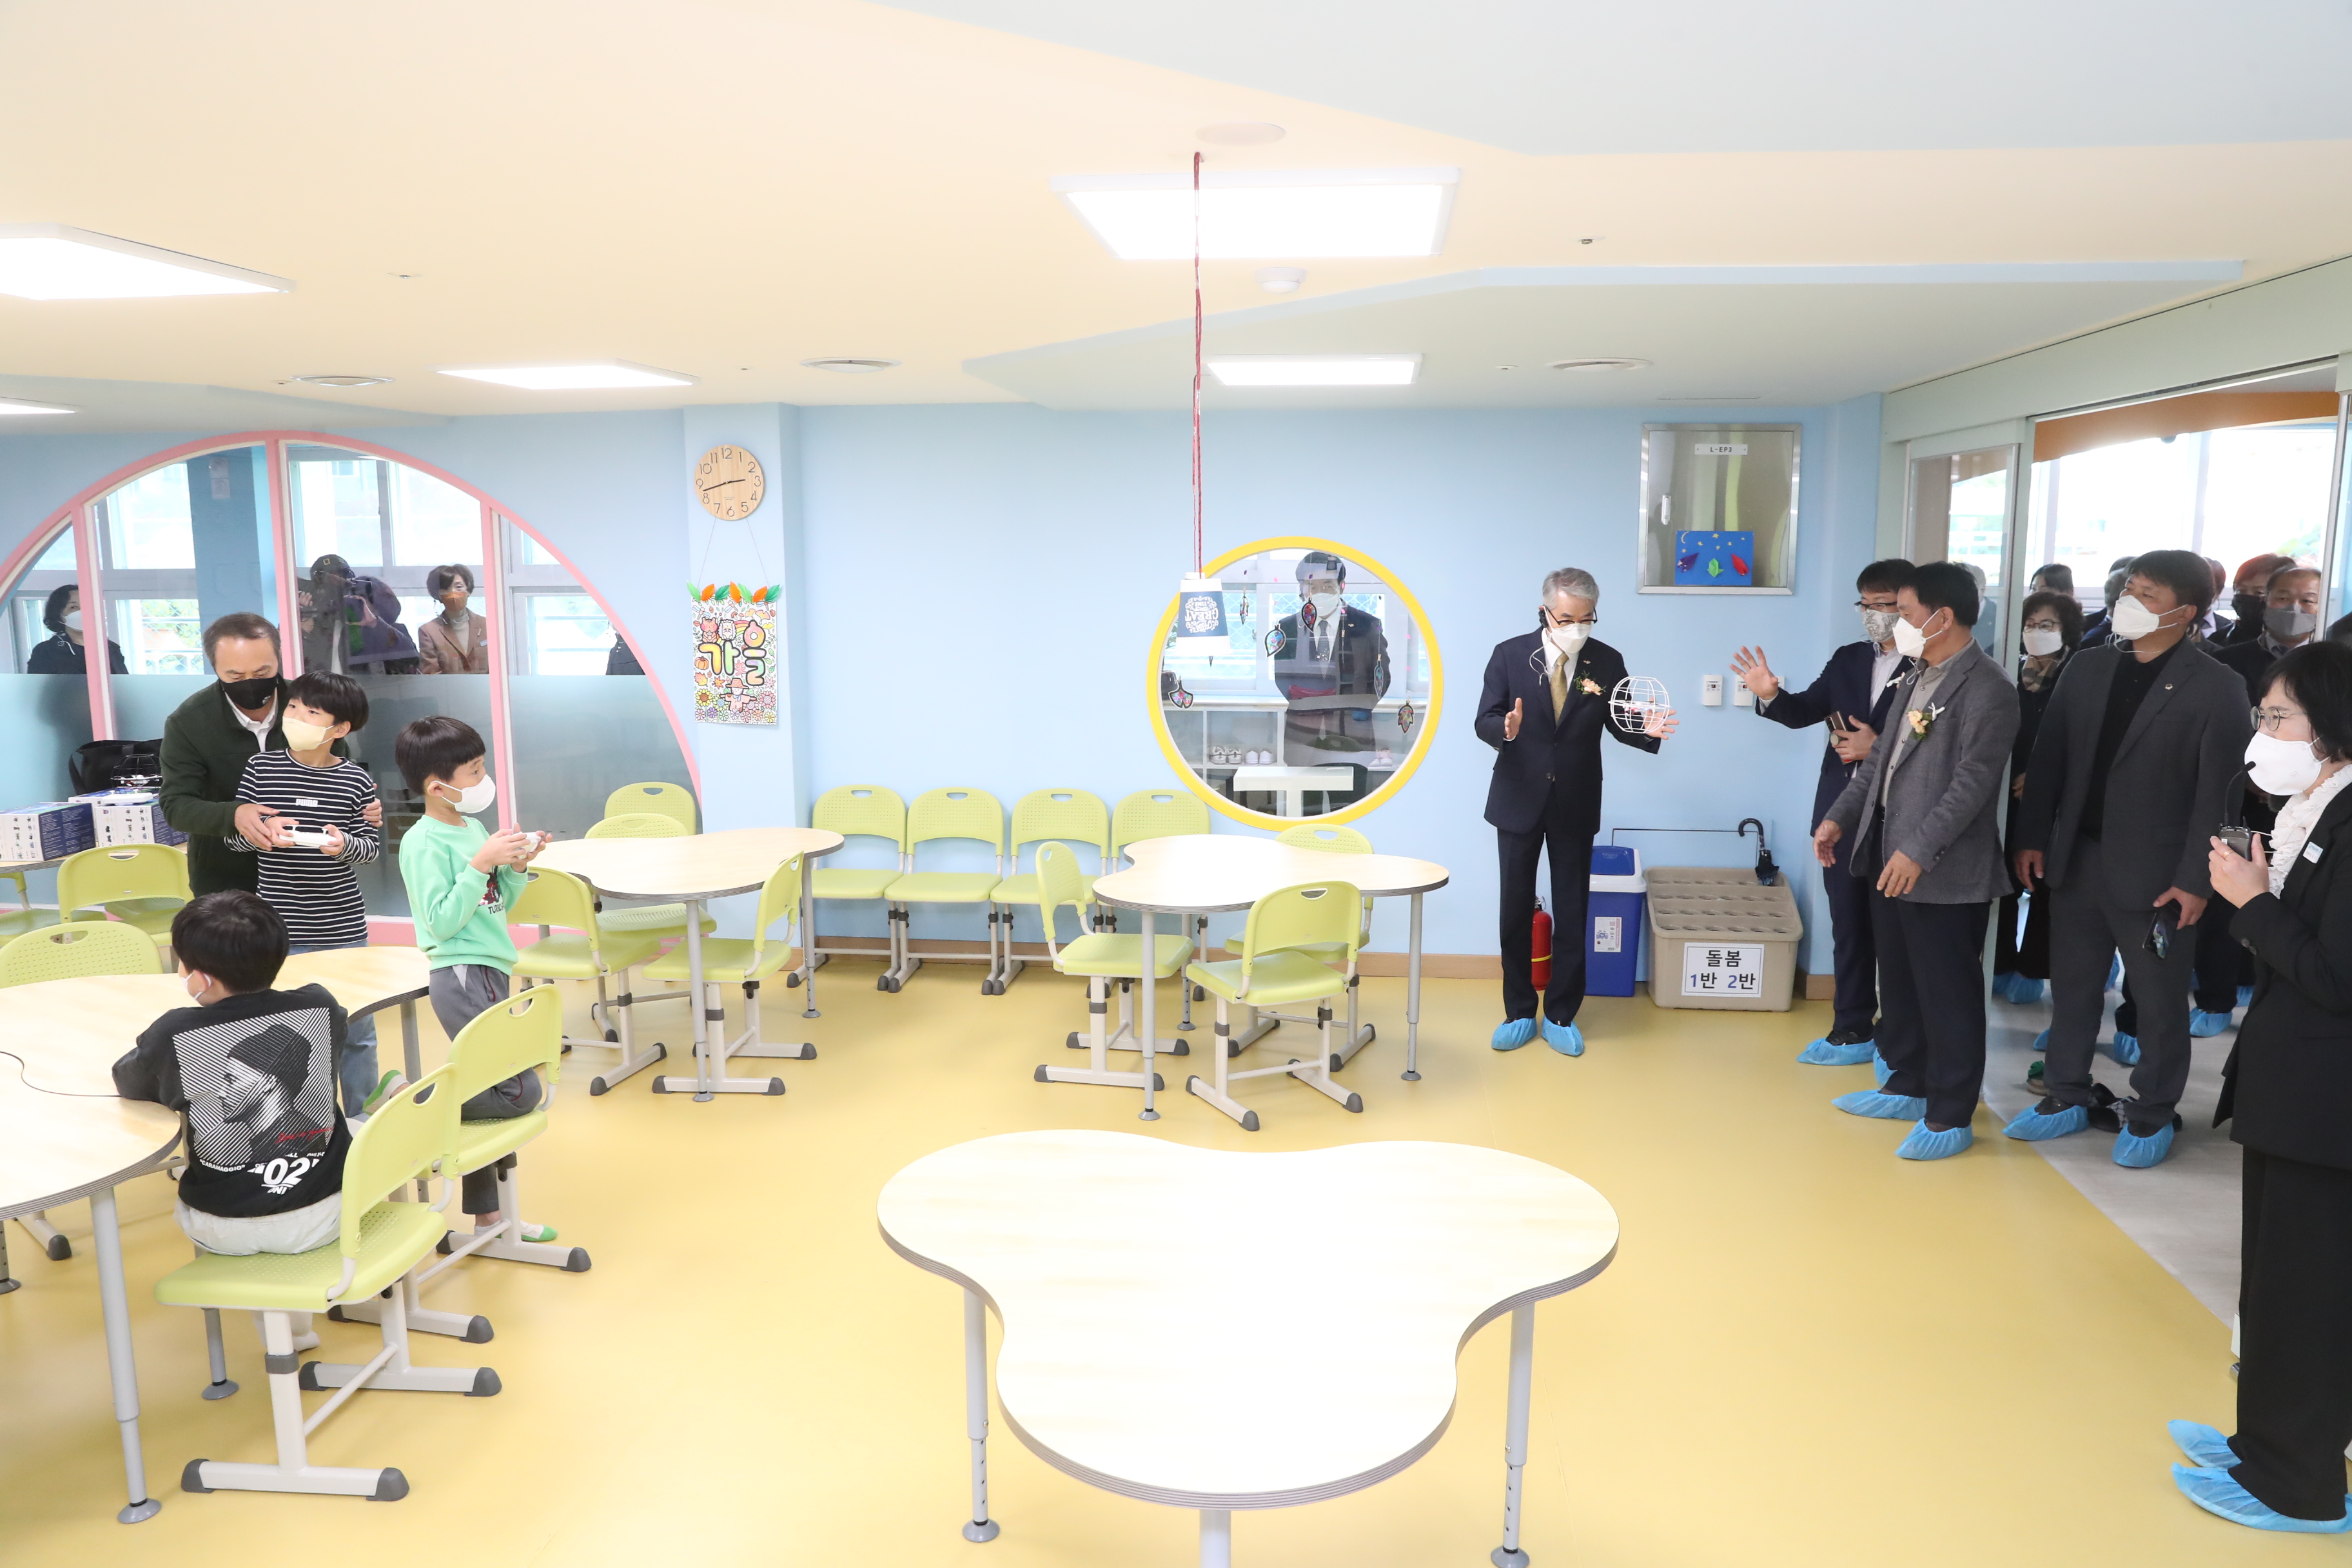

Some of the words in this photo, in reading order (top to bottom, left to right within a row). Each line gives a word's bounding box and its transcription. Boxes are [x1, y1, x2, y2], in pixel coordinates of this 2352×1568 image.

[710, 452, 718, 464] 11
[721, 447, 732, 459] 12
[699, 463, 712, 475] 10
[748, 462, 756, 473] 2
[696, 478, 704, 489] 9
[754, 475, 761, 487] 3
[702, 492, 710, 504] 8
[750, 490, 758, 502] 4
[714, 503, 721, 514] 7
[727, 505, 735, 517] 6
[741, 502, 749, 513] 5
[1184, 607, 1219, 622] GREAT
[698, 620, 767, 687] 가을
[1706, 950, 1741, 967] 돌봄
[1690, 972, 1718, 988] 1반
[1728, 973, 1756, 990] 2반
